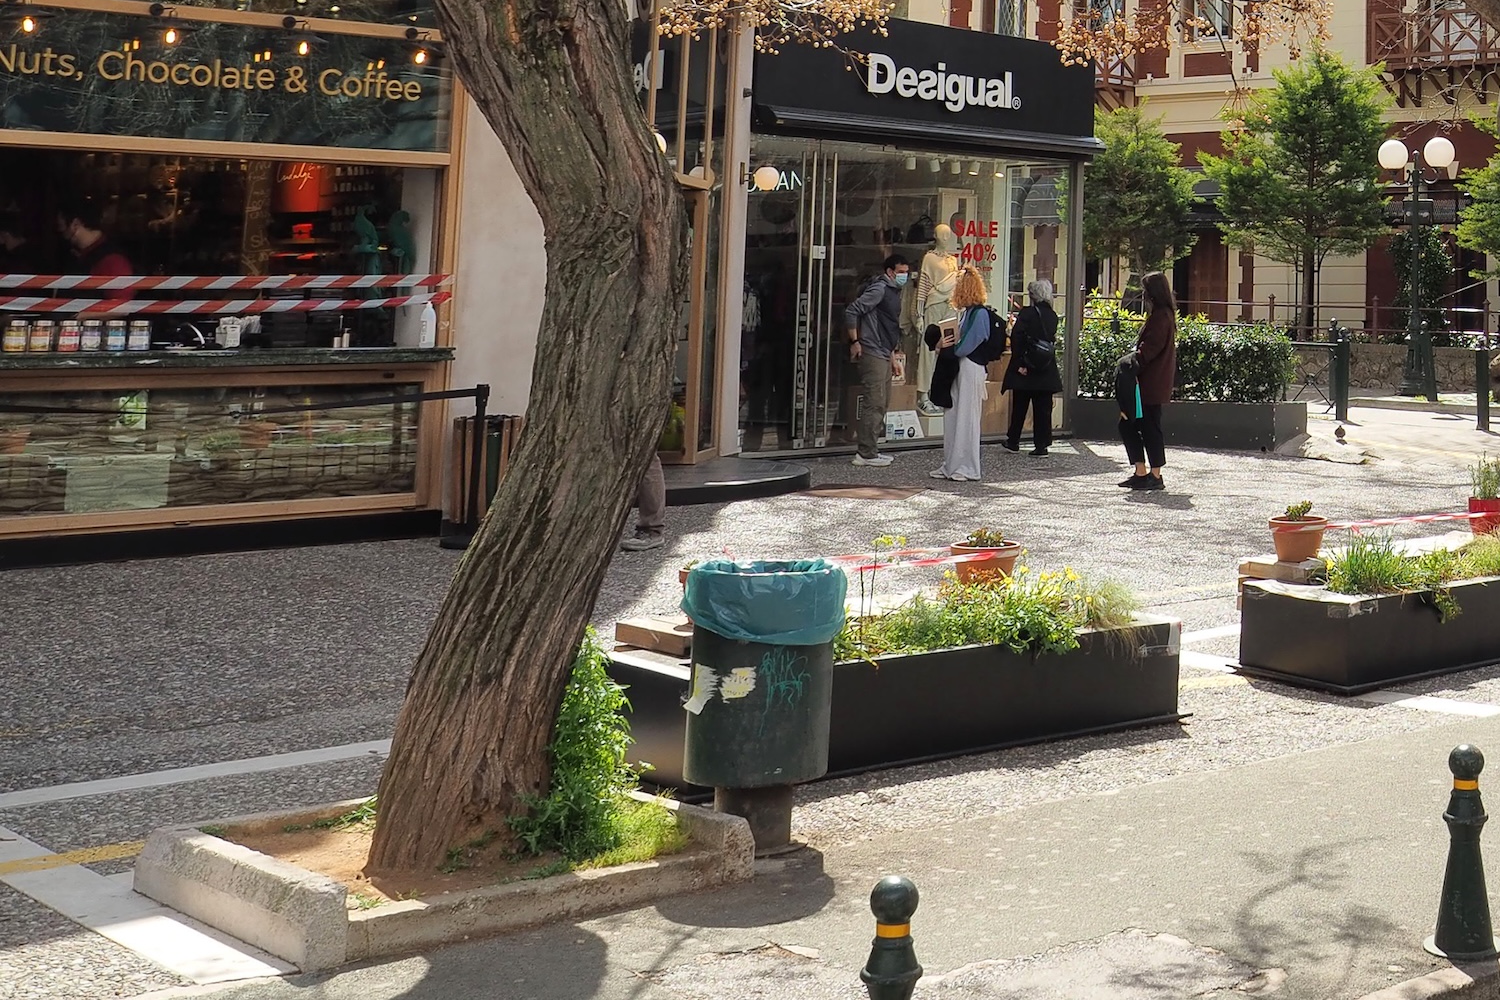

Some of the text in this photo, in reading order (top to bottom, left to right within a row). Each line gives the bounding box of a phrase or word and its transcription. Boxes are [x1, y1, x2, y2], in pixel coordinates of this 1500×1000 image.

[0, 44, 422, 101] Nuts, Chocolate & Coffee
[868, 52, 1013, 113] Desigual
[954, 219, 998, 239] SALE
[953, 242, 997, 262] -40%
